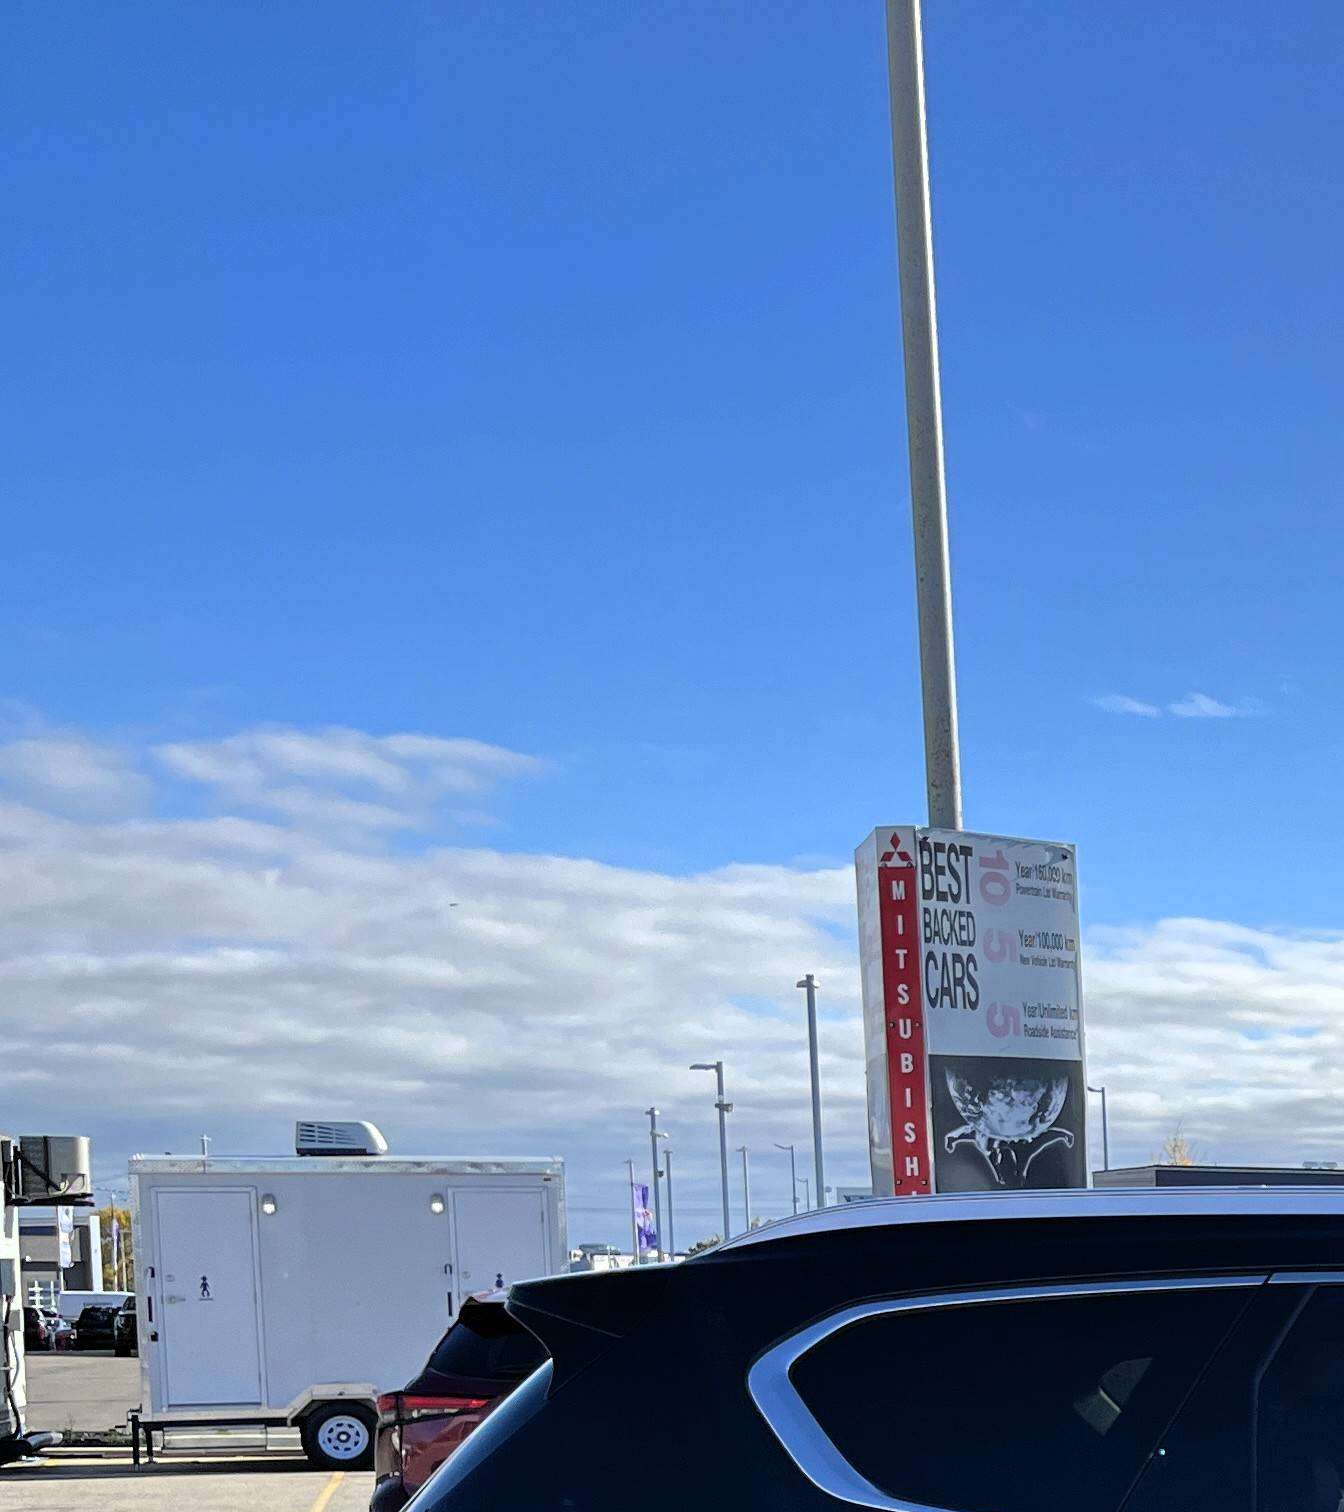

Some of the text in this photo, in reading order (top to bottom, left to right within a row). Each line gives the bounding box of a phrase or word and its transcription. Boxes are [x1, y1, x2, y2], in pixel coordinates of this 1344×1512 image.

[919, 839, 973, 905] BEST
[922, 906, 977, 948] BACKED
[925, 950, 980, 1012] CARS
[891, 879, 923, 1196] MITSUBISH
